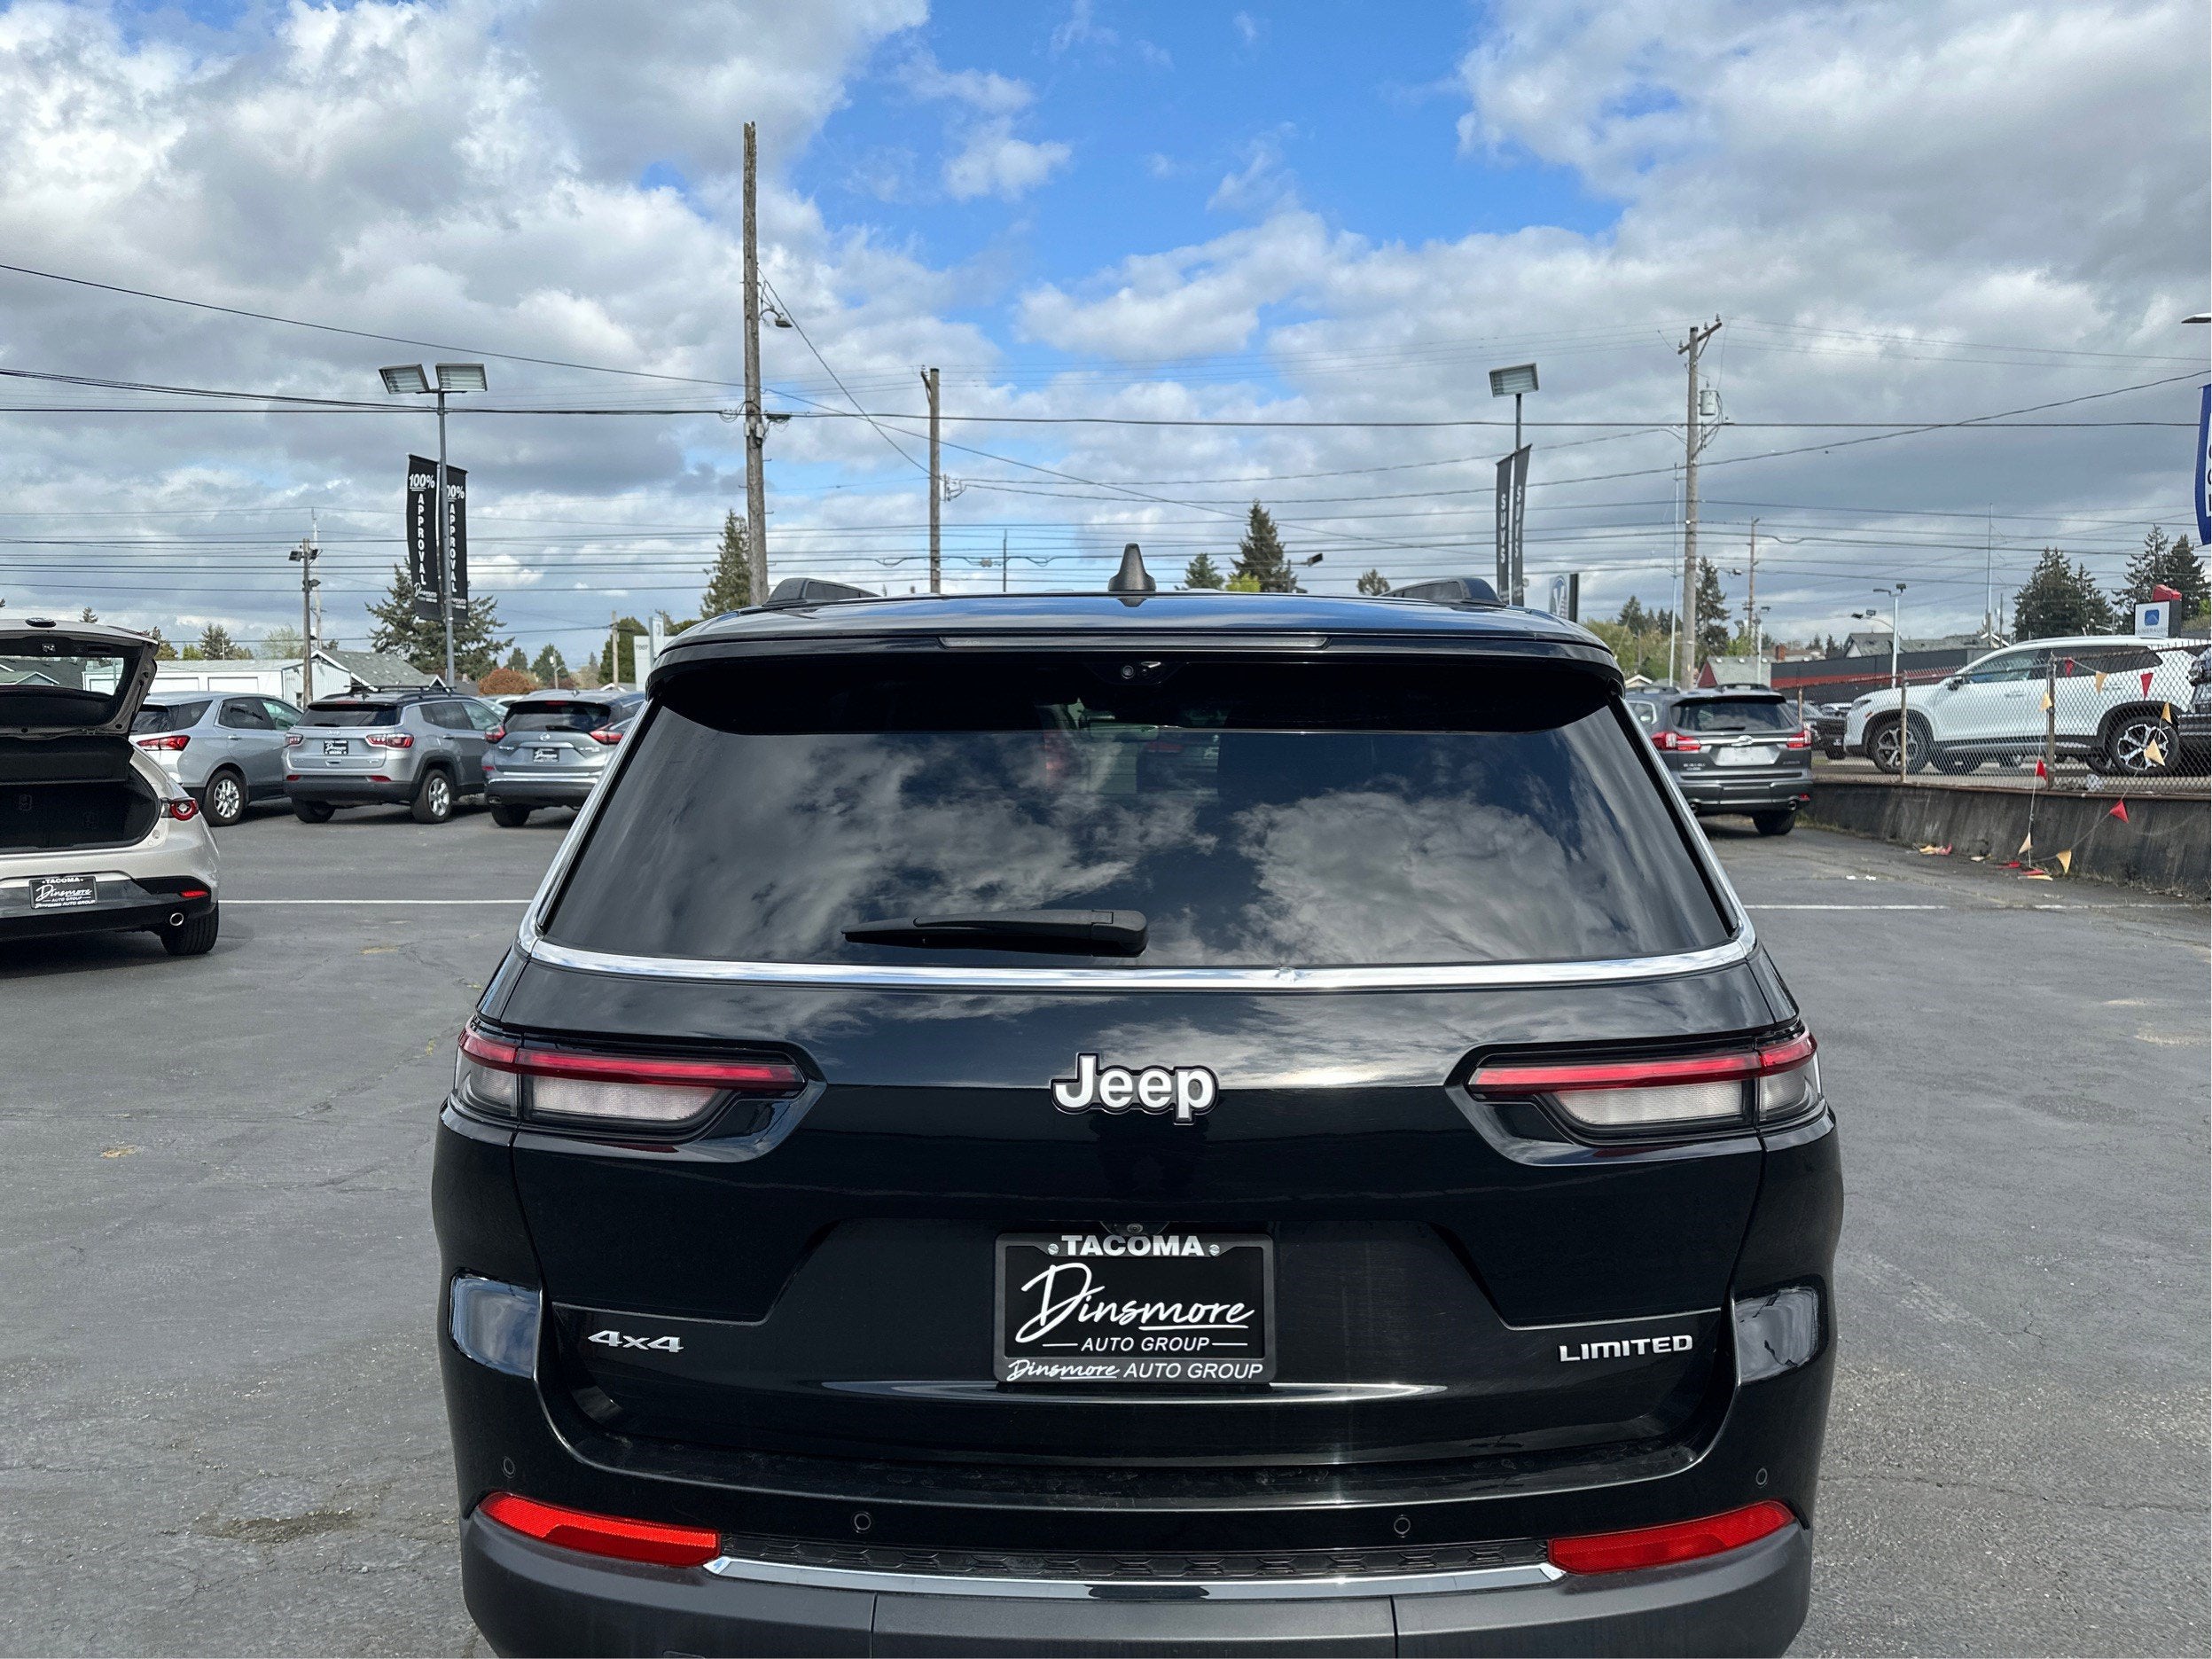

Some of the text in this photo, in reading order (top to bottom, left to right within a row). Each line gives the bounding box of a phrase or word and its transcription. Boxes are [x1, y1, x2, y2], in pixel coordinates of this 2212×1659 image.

[409, 473, 435, 489] 100%
[418, 493, 426, 585] APPROVAL
[1051, 1053, 1218, 1123] Jeep
[1060, 1234, 1205, 1257] TACOMA
[1015, 1262, 1255, 1343] Dinsmore
[587, 1329, 684, 1353] 4x4
[1081, 1337, 1211, 1352] AUTO GROUP
[1559, 1334, 1693, 1363] LIMITED
[1006, 1359, 1264, 1381] Dinsmore AUTO GROUP
